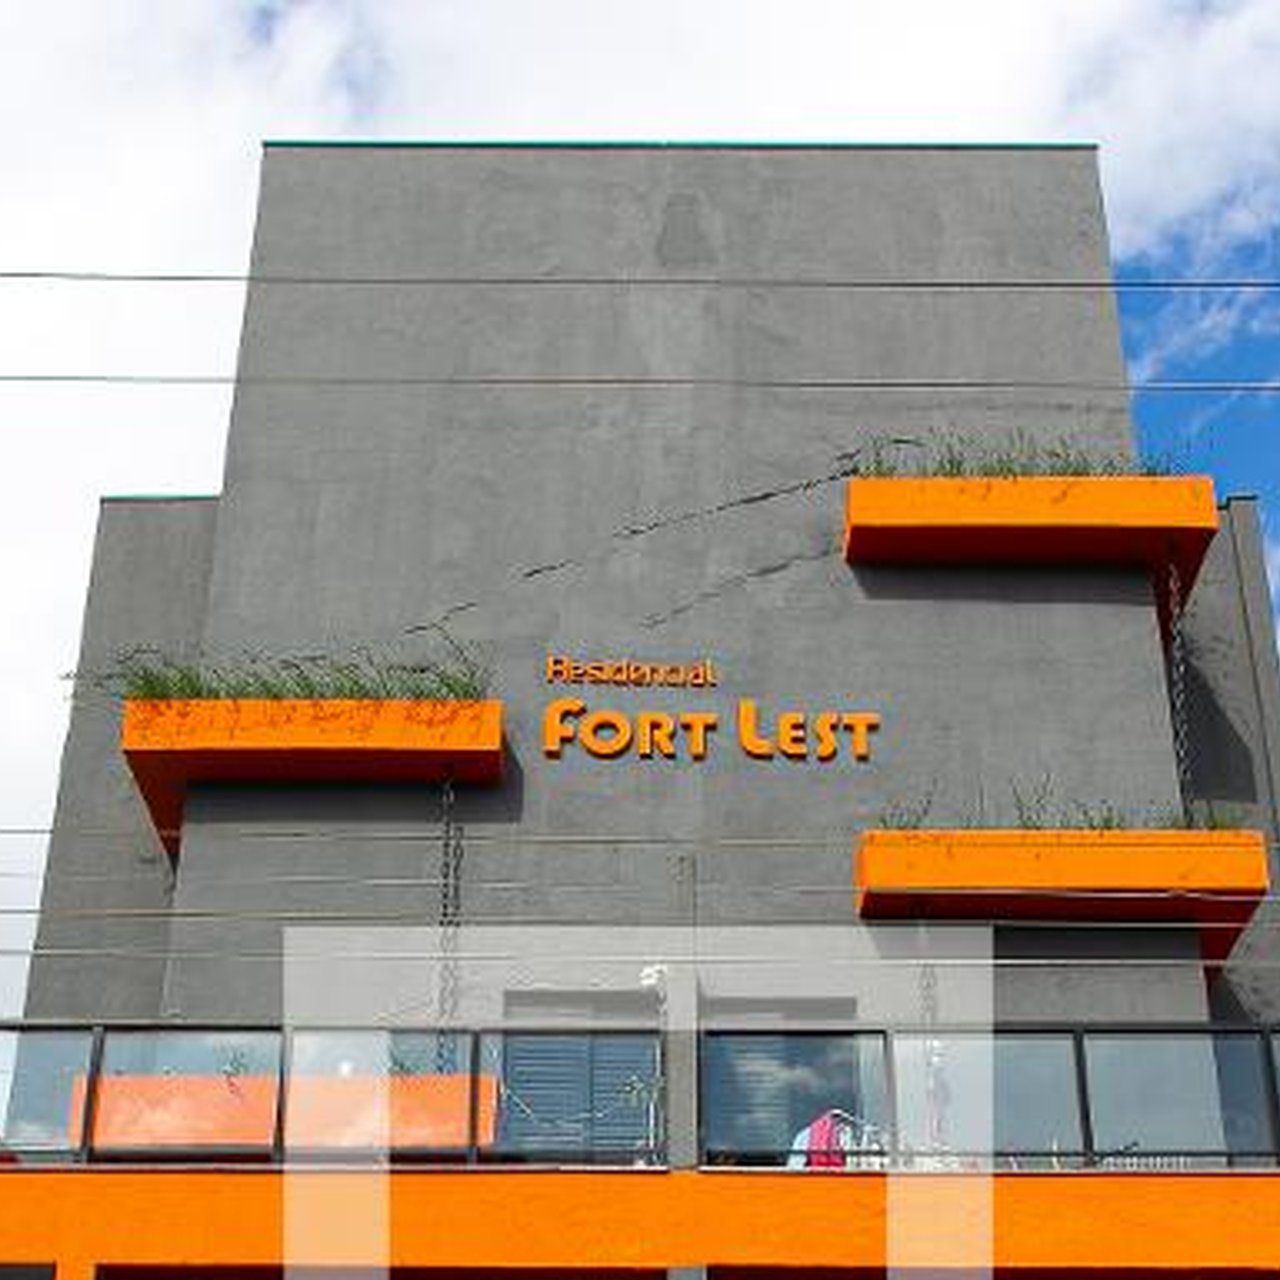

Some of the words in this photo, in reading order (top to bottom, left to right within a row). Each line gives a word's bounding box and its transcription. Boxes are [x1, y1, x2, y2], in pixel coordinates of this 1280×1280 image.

[546, 654, 717, 686] Residencial
[543, 698, 718, 760] FORT
[737, 698, 881, 760] LEST
